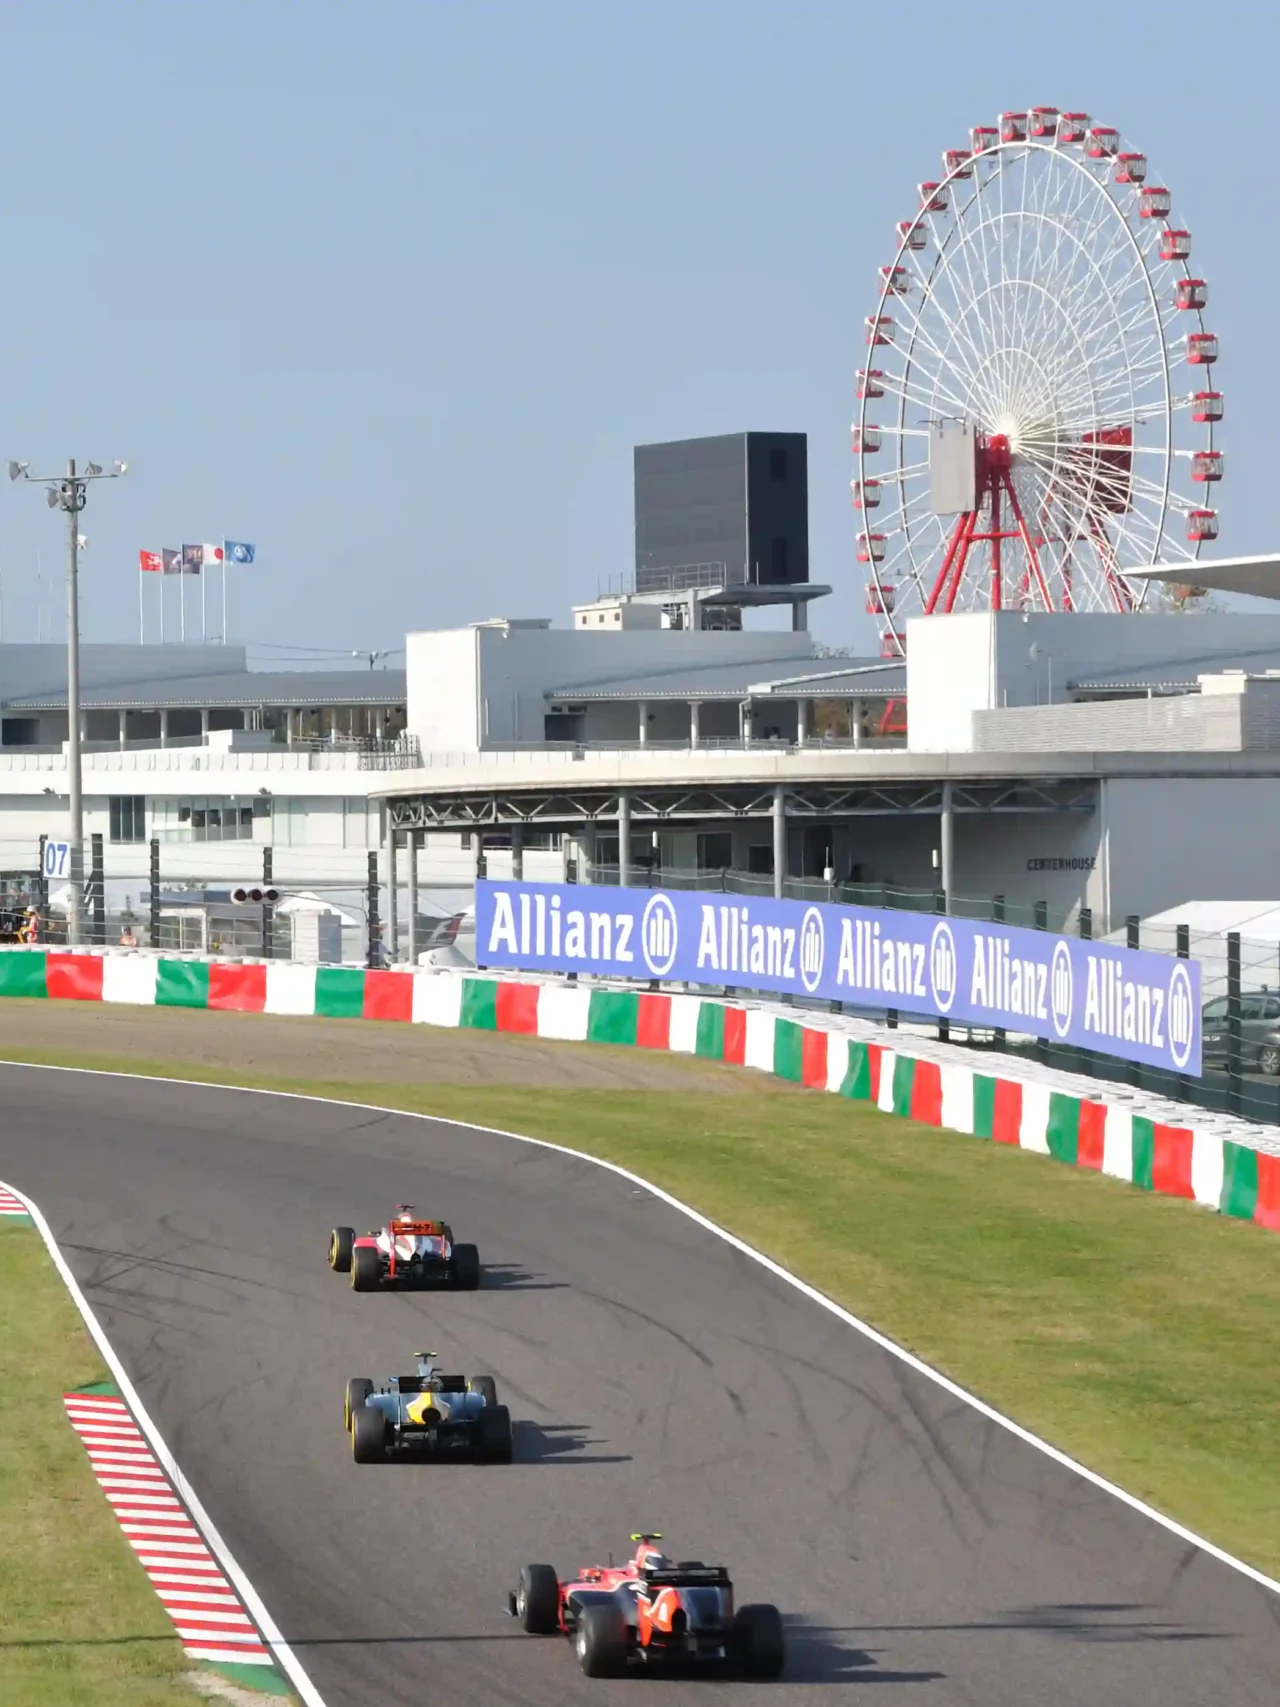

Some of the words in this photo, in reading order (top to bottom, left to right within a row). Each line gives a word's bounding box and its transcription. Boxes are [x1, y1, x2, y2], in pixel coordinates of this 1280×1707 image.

[46, 843, 67, 875] 07
[1026, 857, 1096, 870] CENTERHOUSE
[489, 892, 634, 961] Allianz
[697, 905, 796, 979] Allianz
[836, 918, 927, 997] Allianz
[971, 934, 1048, 1019] Allianz
[1084, 956, 1165, 1048] Allianz
